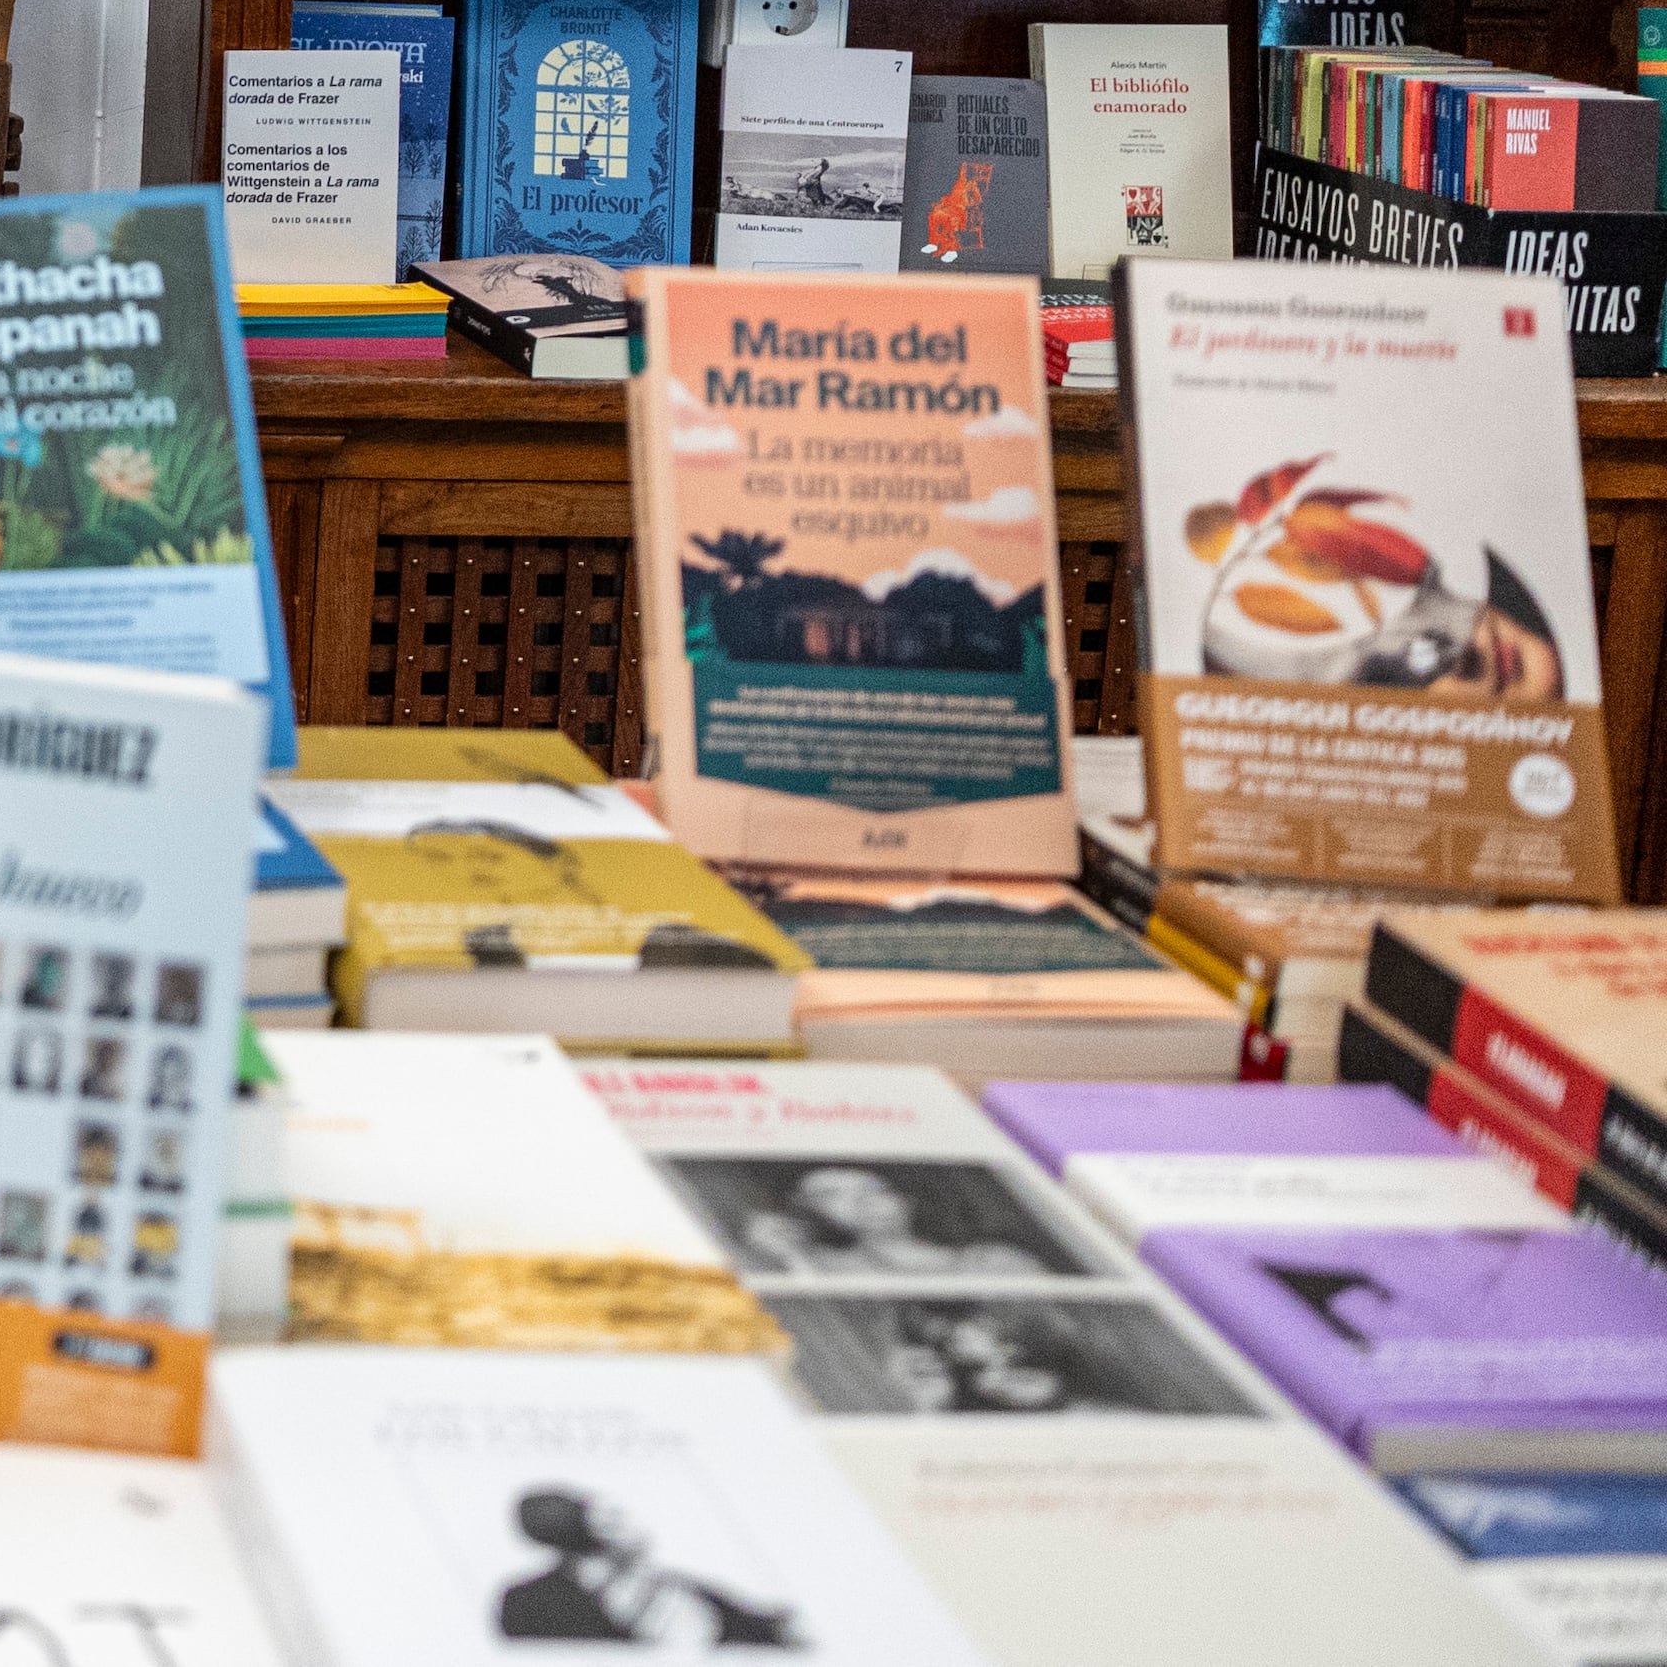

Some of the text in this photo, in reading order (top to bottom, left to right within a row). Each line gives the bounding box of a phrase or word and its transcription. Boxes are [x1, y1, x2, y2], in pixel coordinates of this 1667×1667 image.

[549, 6, 623, 21] CHARLOTTE
[1330, 12, 1405, 47] IDEAS
[894, 61, 904, 73] 7
[1111, 60, 1167, 69] Alexis Martin
[228, 74, 383, 88] Comentarios a La rama
[1089, 76, 1189, 94] El bibliófilo
[228, 91, 339, 106] dorada de Frazer
[957, 95, 1009, 115] RITUALES
[1093, 98, 1187, 115] enamorado
[256, 117, 372, 126] LUDWIG WITTGENSTEIN
[957, 116, 1027, 136] DE UN CULTO
[1506, 109, 1551, 131] MANUEL
[227, 143, 348, 157] Comentarios a los
[957, 137, 1040, 157] DESAPARECIDO
[1506, 133, 1538, 156] RIVAS
[226, 159, 330, 173] comentarios de
[226, 175, 380, 191] Wittgenstein a La rama
[226, 190, 339, 204] dorada de Frazer
[522, 188, 643, 216] El profesor
[271, 216, 352, 225] DAVID GRAEBER
[1261, 167, 1463, 272] ENSAYOS BREVES
[1504, 230, 1589, 280] IDEAS
[729, 320, 968, 364] María del
[16, 357, 135, 394] noche
[703, 366, 1000, 418] Mar Ramón
[749, 431, 963, 470] La memoria
[744, 465, 972, 504] es un animal
[791, 508, 929, 543] esquivo
